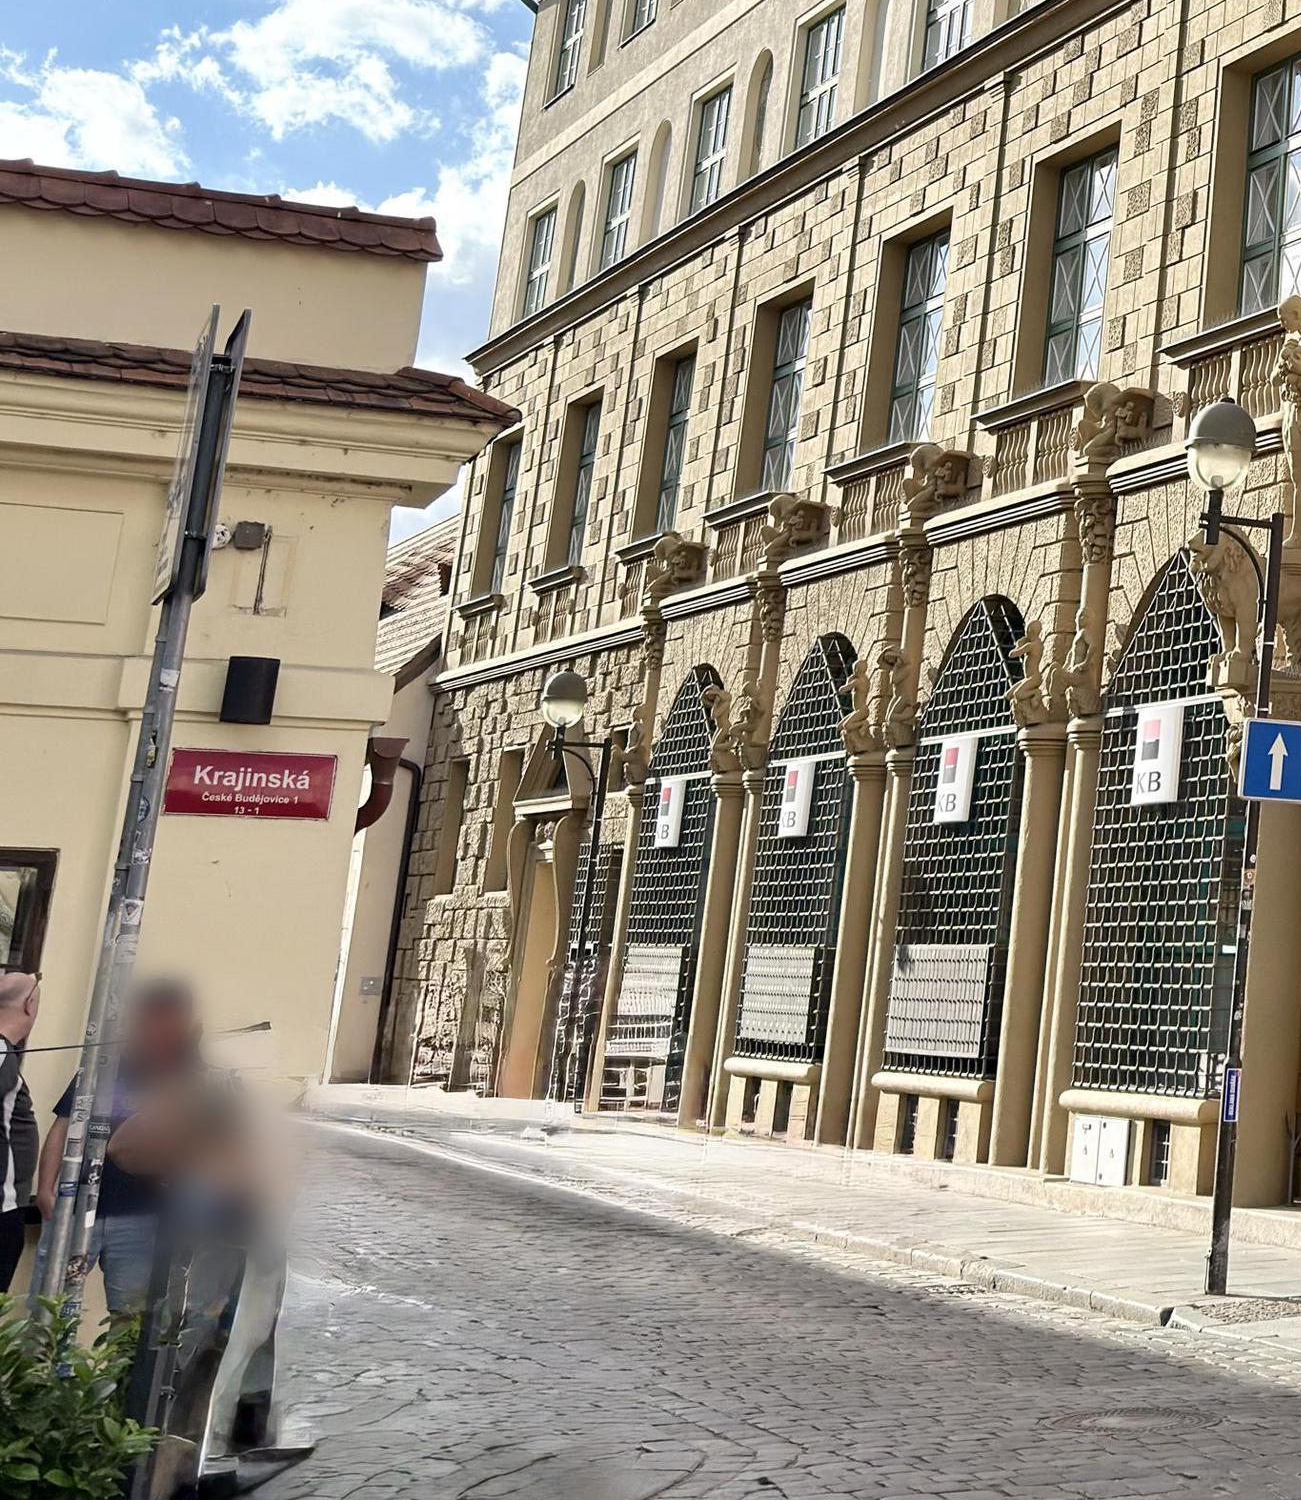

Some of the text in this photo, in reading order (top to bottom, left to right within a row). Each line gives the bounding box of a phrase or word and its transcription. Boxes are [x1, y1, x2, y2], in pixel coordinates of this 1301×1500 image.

[193, 764, 311, 791] Krajinská
[1136, 770, 1162, 794] KB
[201, 791, 298, 805] České Budějovice 1
[937, 793, 957, 812] KB
[233, 806, 245, 814] 13
